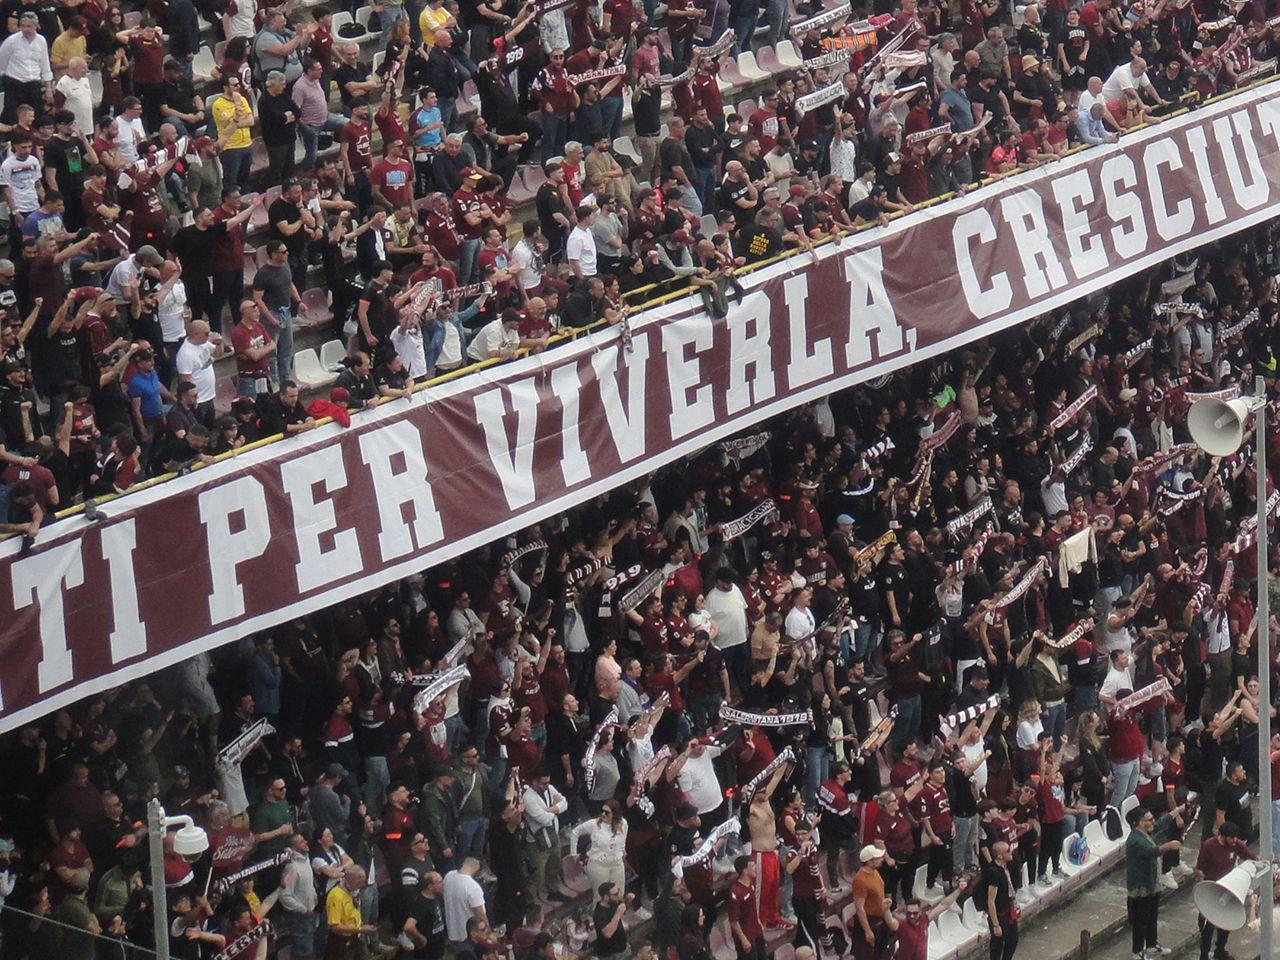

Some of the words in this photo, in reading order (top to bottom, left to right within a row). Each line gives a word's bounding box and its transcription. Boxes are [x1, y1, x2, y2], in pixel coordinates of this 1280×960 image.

[506, 47, 524, 65] 1919
[1, 518, 147, 710] TI
[198, 419, 444, 626] PER
[473, 245, 916, 511] VIVERLA,
